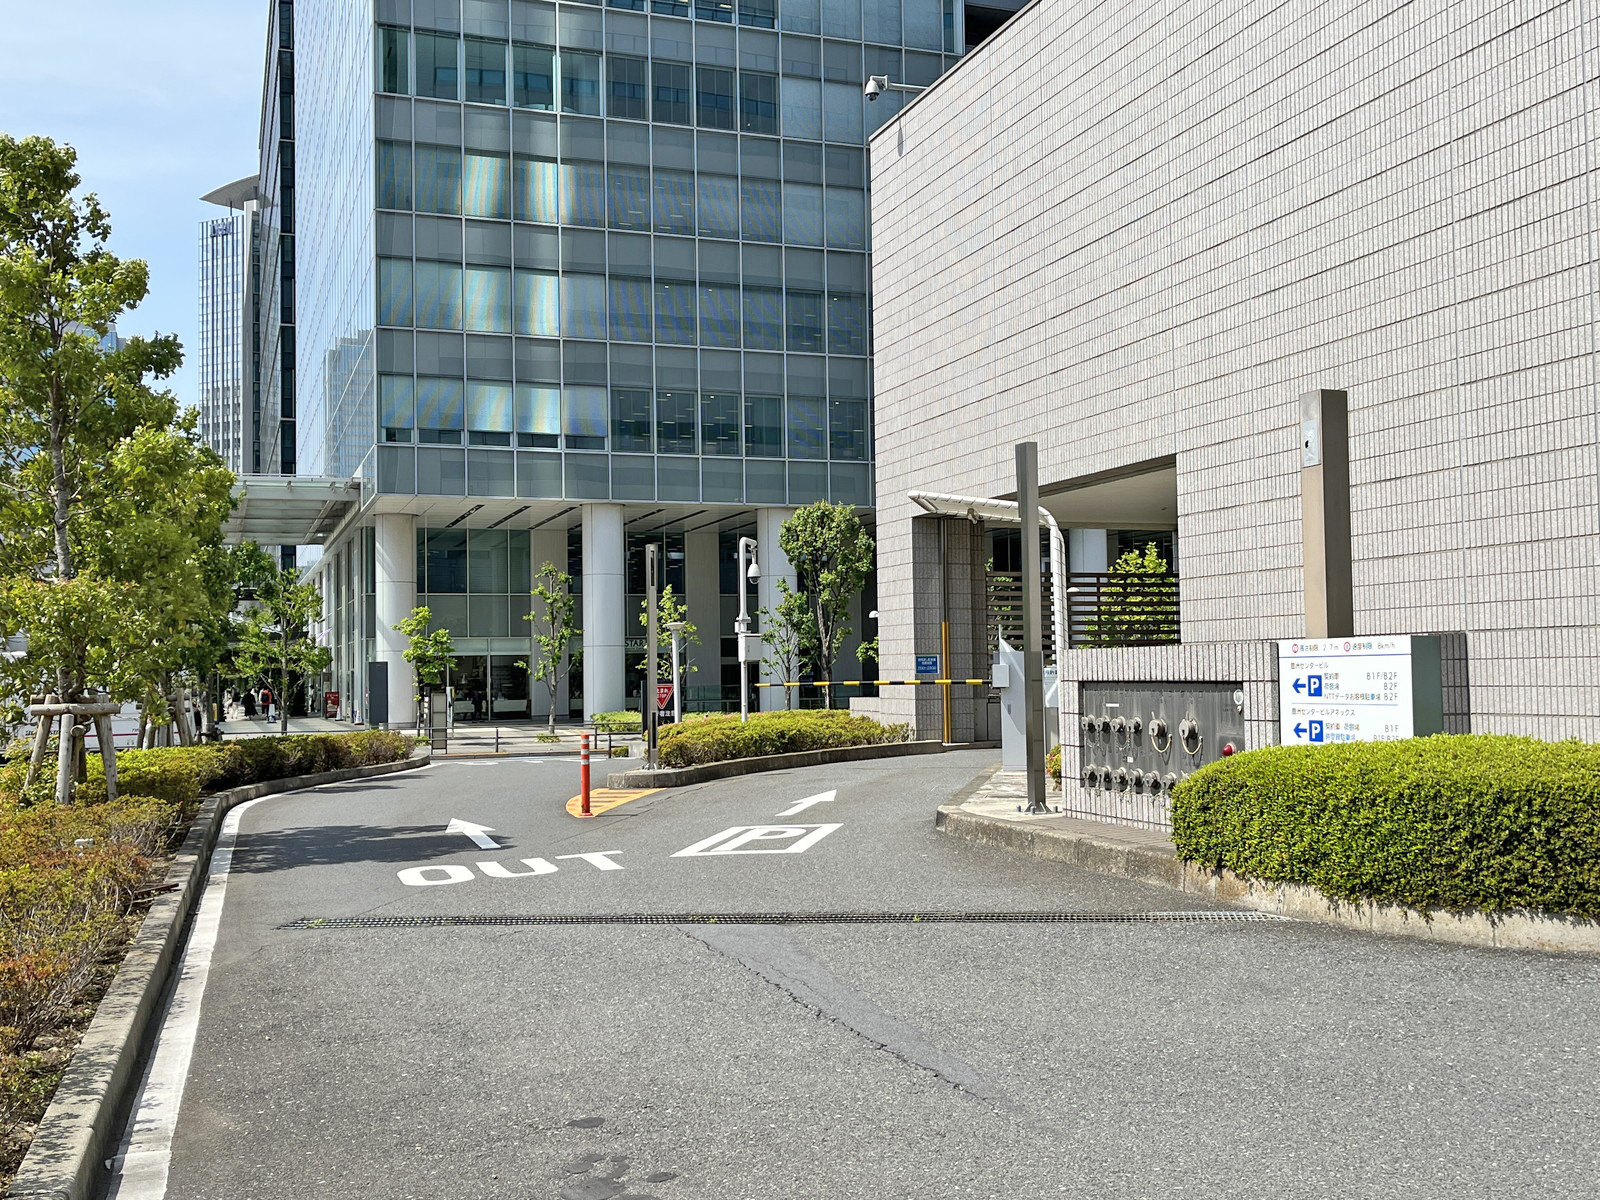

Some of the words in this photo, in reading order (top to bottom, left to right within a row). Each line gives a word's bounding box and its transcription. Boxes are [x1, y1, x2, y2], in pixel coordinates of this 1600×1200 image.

[624, 639, 647, 647] STAR
[1366, 672, 1398, 680] B1F/B2F
[1383, 682, 1398, 690] B2F
[1383, 692, 1398, 701] B2F
[1384, 724, 1399, 733] B1F
[396, 850, 625, 887] OUT
